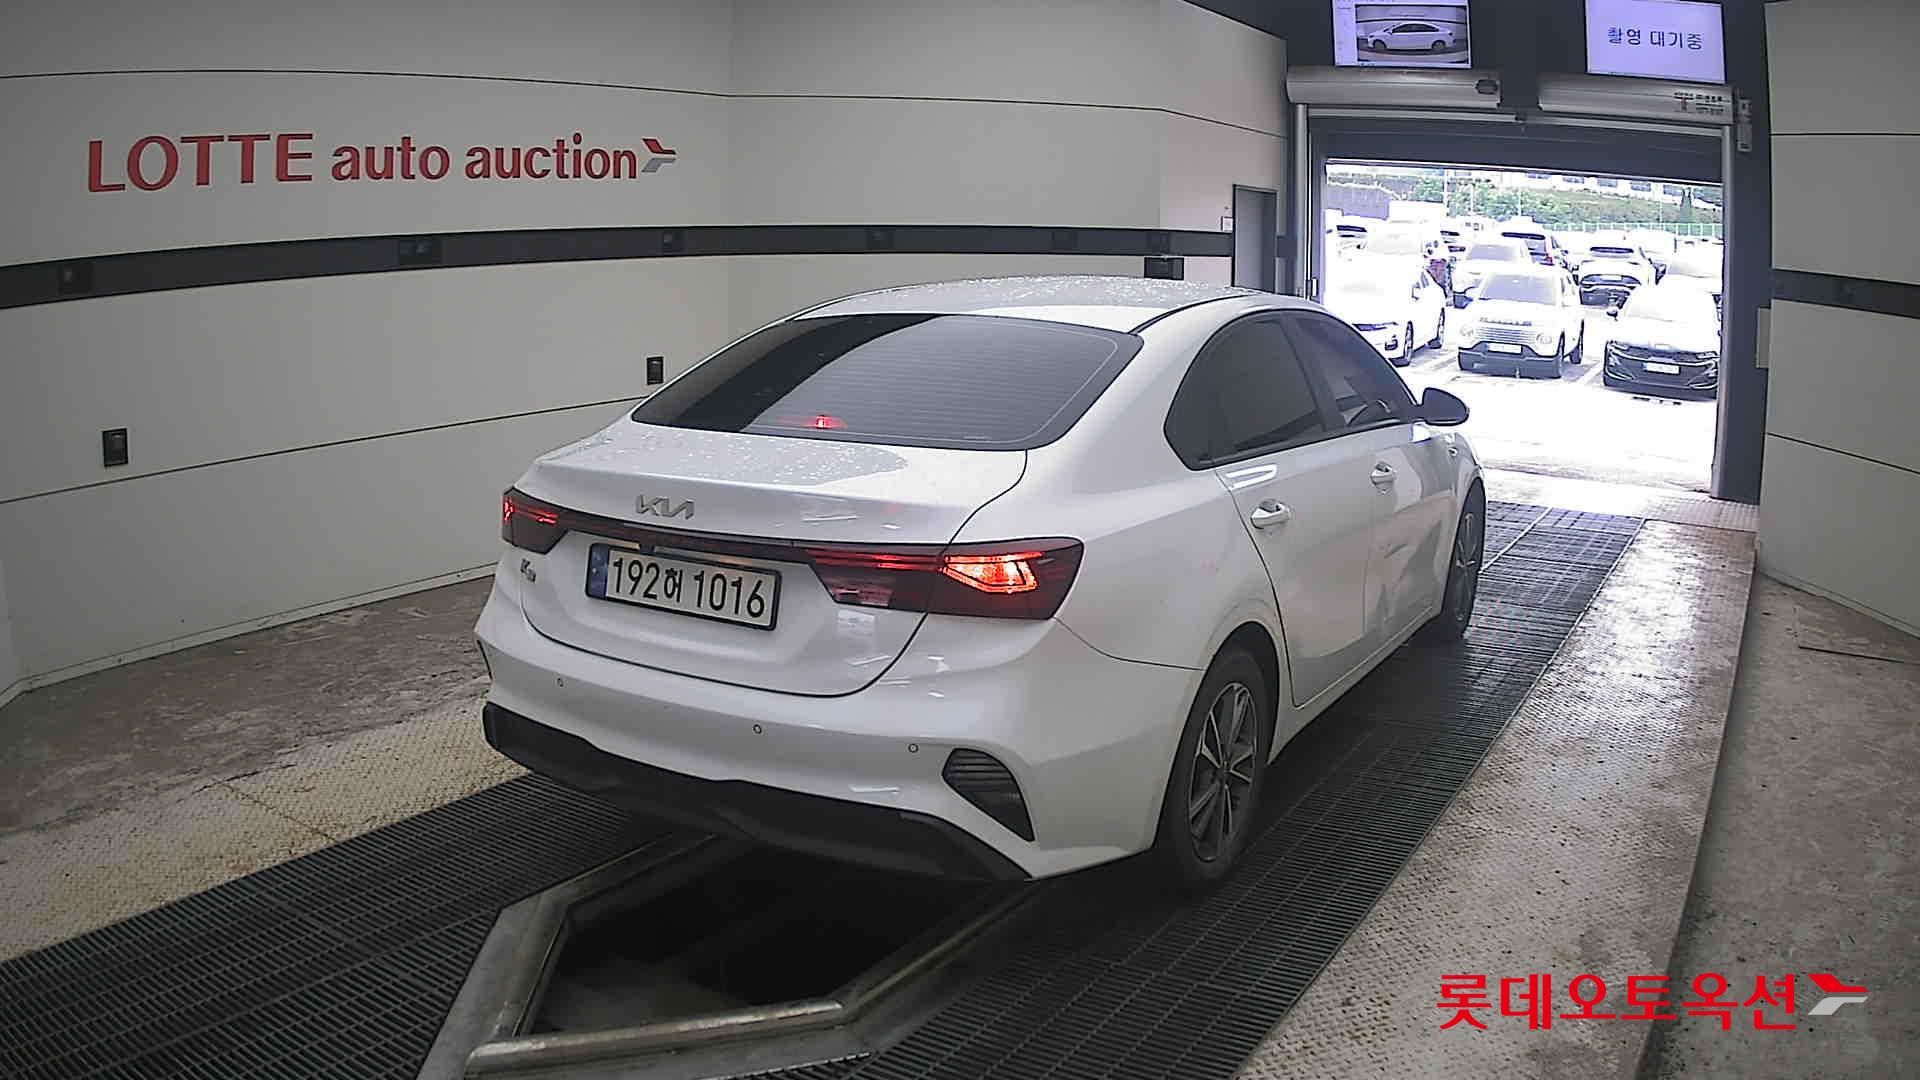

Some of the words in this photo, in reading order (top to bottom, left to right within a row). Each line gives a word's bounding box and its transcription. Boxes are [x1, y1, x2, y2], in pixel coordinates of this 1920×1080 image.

[1649, 30, 1702, 50] 대기중
[88, 133, 312, 192] LOTTE
[331, 136, 450, 181] auto
[465, 132, 638, 179] auction
[635, 494, 695, 520] KIA
[613, 557, 683, 603] 192허
[694, 570, 765, 618] 1016
